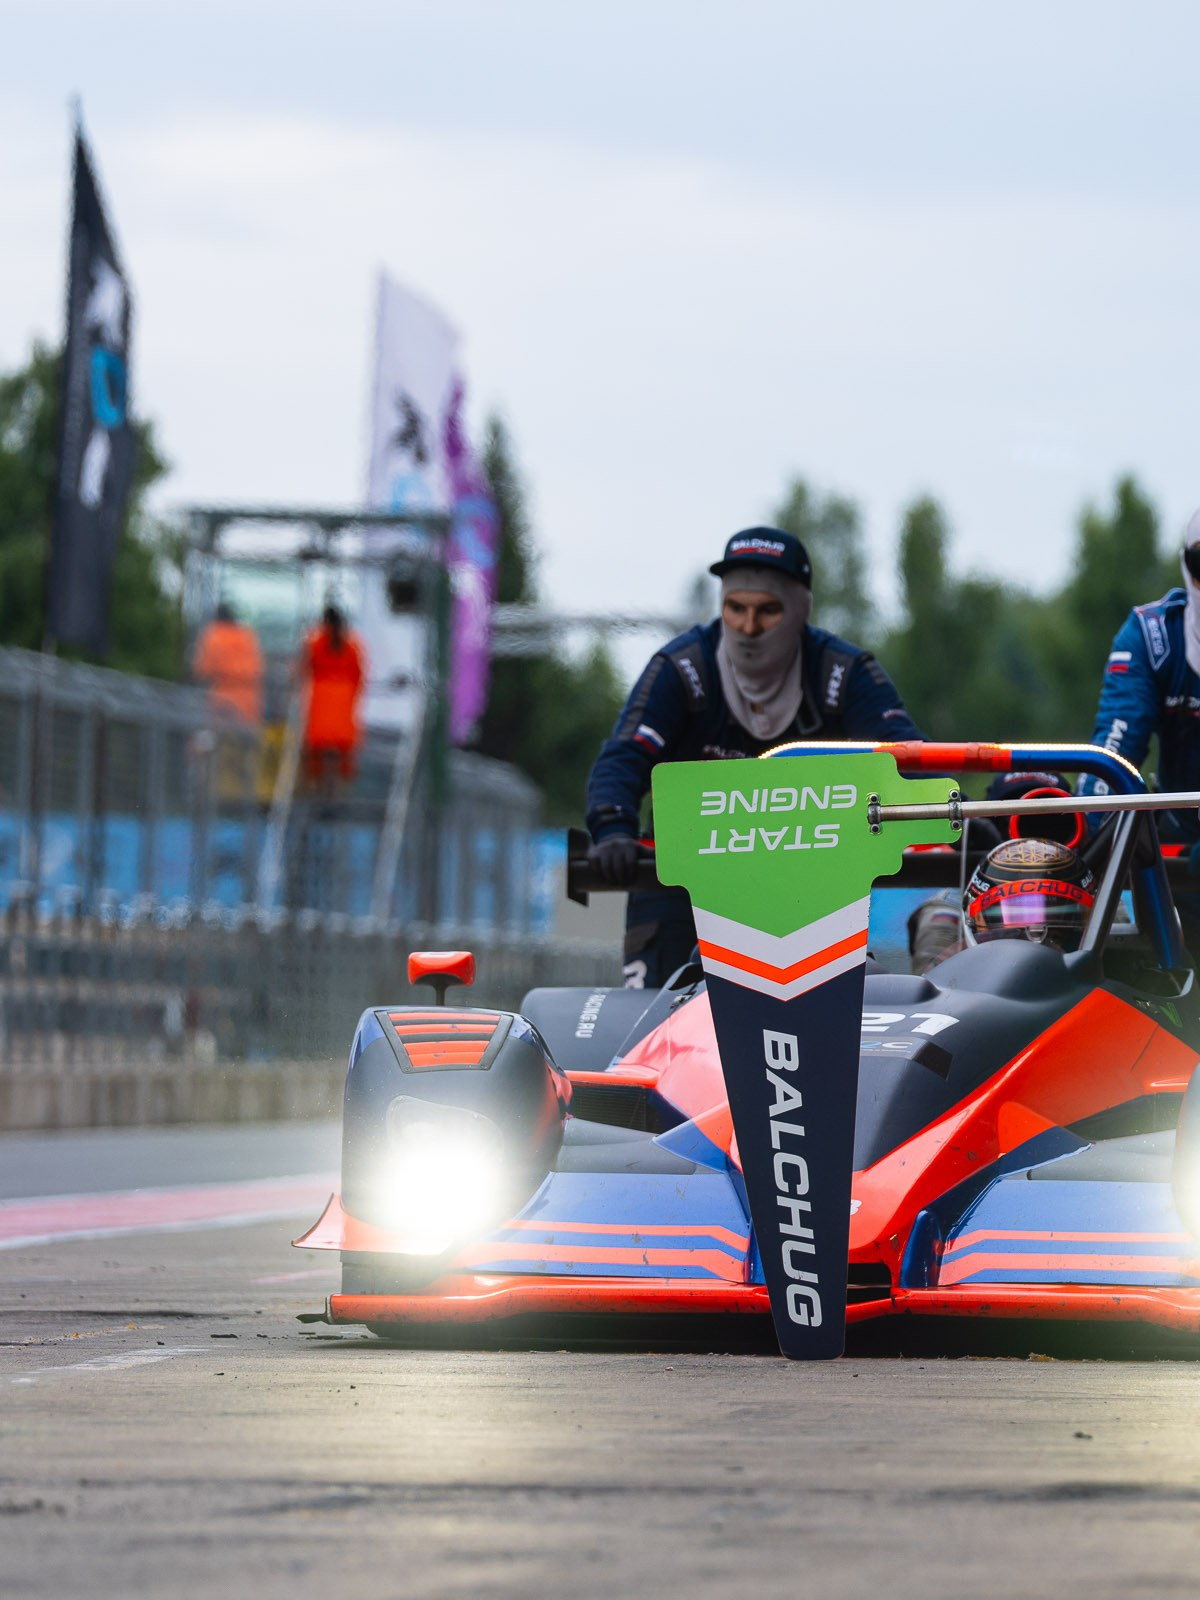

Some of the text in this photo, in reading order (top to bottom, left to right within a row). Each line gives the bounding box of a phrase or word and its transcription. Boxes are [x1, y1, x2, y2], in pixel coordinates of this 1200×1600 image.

[700, 784, 857, 816] ENGINE
[698, 823, 841, 855] START
[980, 880, 1083, 909] BALCHUG
[763, 1029, 823, 1327] BALCHUG
